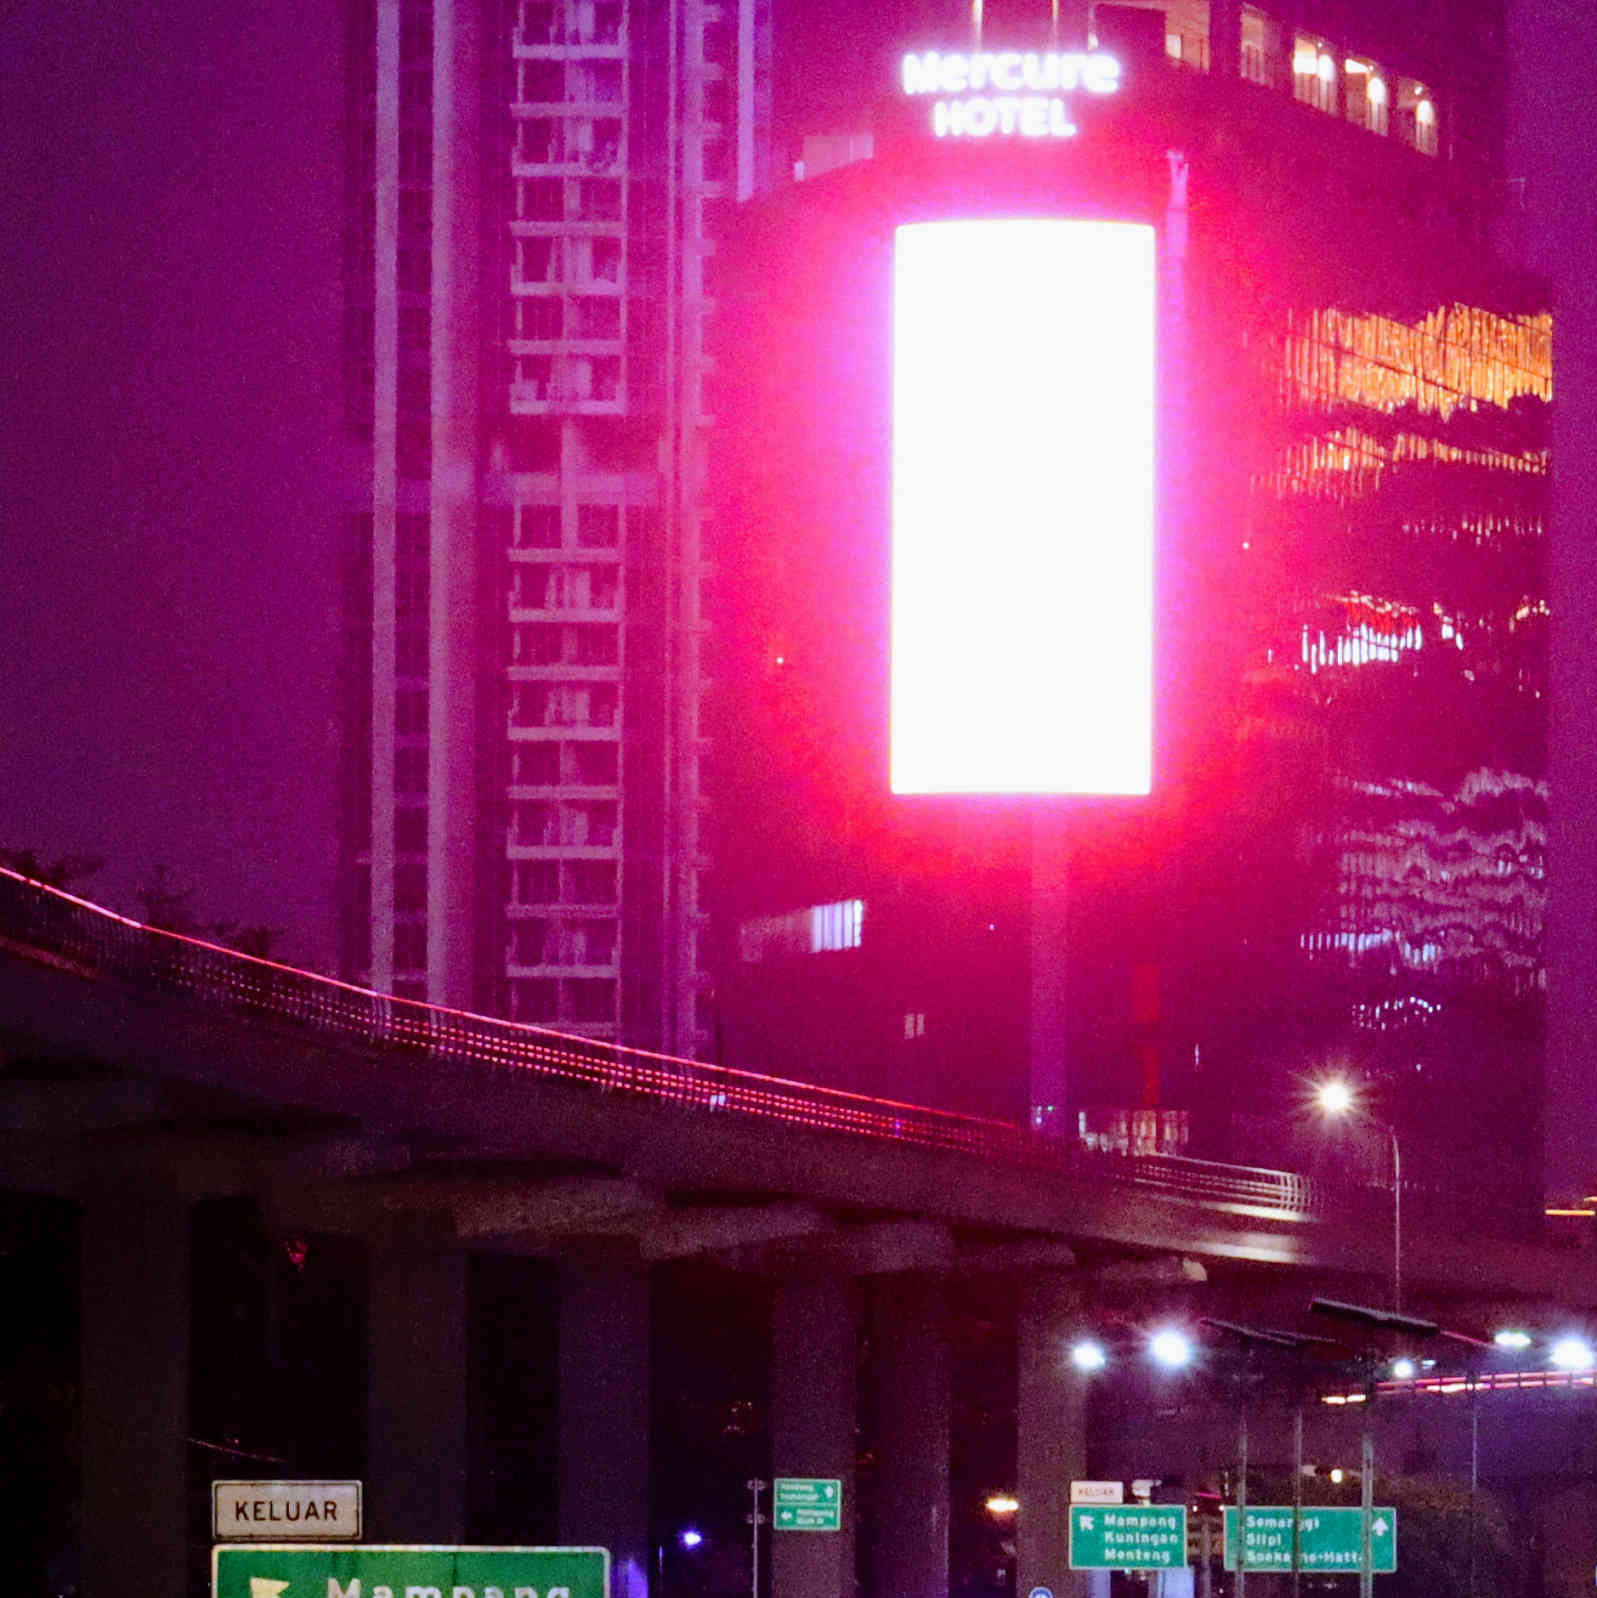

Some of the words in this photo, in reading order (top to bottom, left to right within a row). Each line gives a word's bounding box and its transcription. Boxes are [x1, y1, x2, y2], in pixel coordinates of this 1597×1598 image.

[933, 97, 1077, 137] HOTEL
[235, 1500, 339, 1522] KELUAR
[1103, 1513, 1176, 1530] Mampang
[1103, 1531, 1178, 1546] Kuningan
[1103, 1548, 1171, 1565] Menteng
